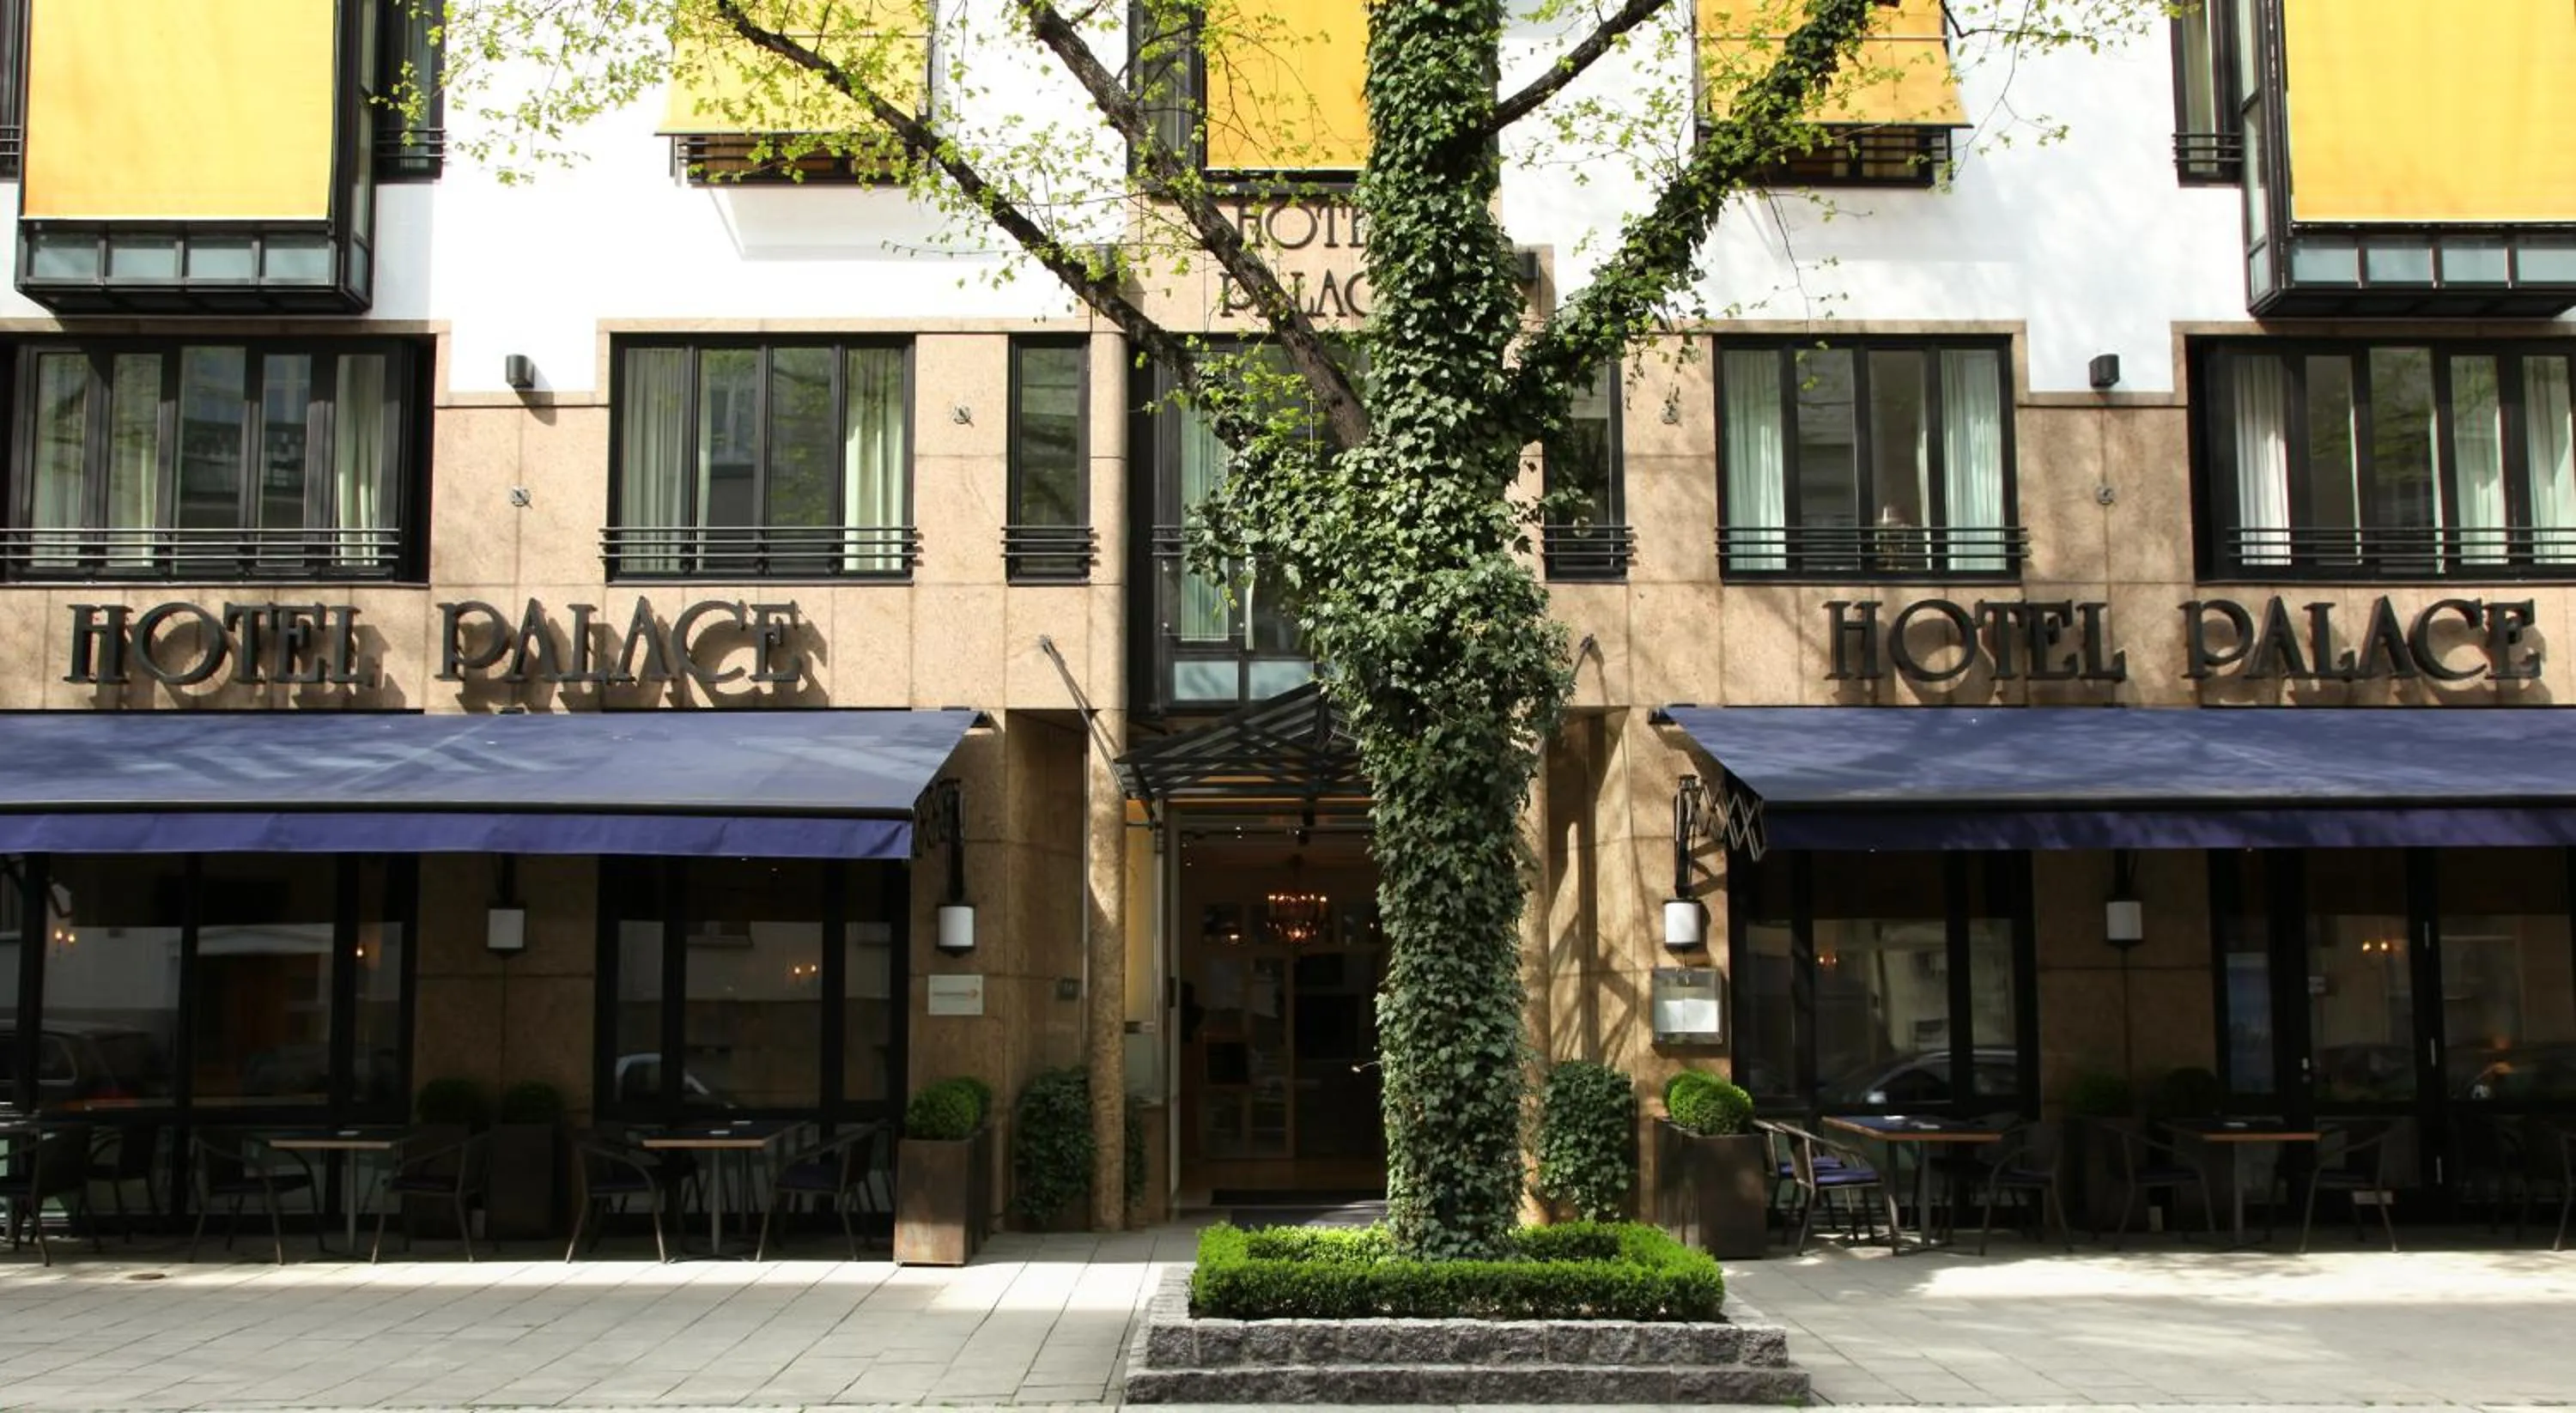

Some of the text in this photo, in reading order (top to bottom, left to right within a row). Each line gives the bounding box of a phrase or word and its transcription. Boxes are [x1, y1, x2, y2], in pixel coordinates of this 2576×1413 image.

[1236, 200, 1370, 250] HOTE
[63, 595, 802, 687] HOTEL PALACE
[1823, 595, 2543, 683] HOTEL PALACE
